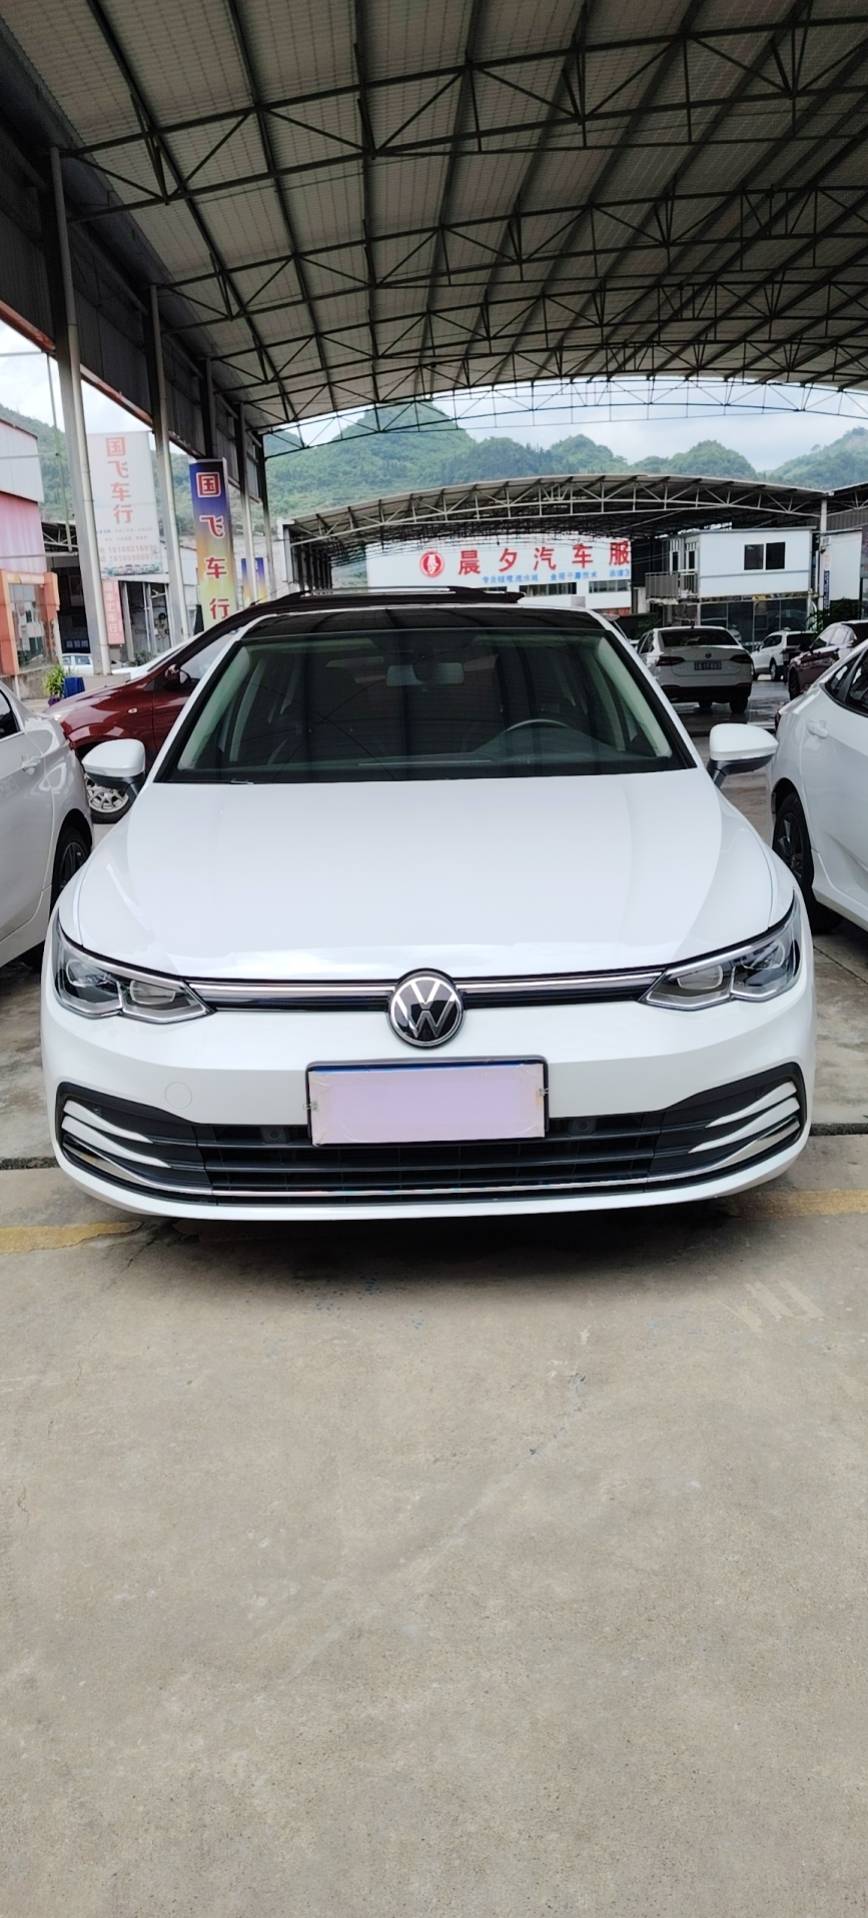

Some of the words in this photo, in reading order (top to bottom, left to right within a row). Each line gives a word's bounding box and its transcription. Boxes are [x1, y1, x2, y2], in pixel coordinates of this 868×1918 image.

[106, 437, 133, 525] 国飞车行
[196, 472, 230, 620] 国飞车行
[458, 540, 630, 575] 晨夕汽车服
